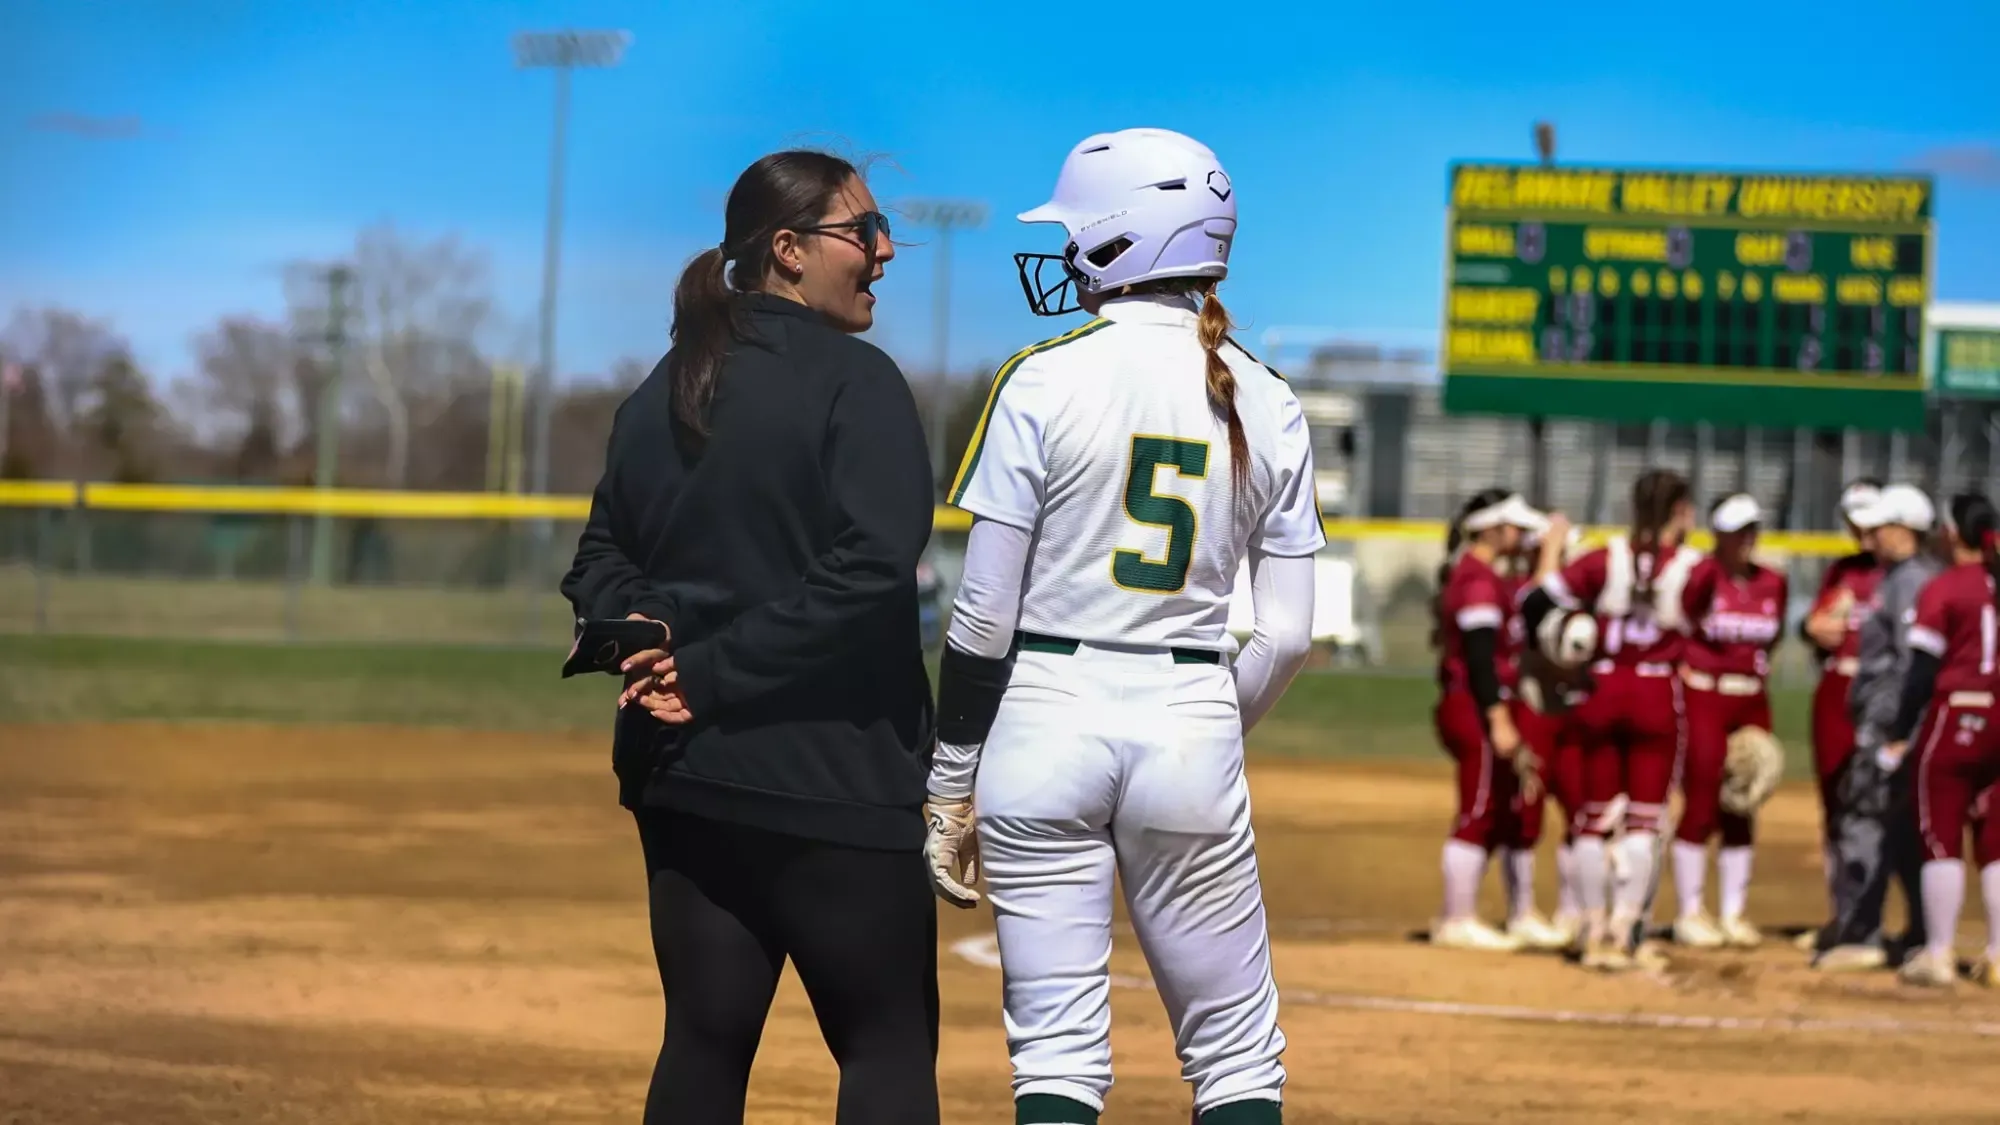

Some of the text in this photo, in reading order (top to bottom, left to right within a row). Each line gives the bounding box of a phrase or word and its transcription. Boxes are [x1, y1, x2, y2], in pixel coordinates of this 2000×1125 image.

[1622, 172, 1732, 215] VALLEY
[1738, 177, 1924, 222] UNIVERSITY
[1109, 434, 1211, 595] 5
